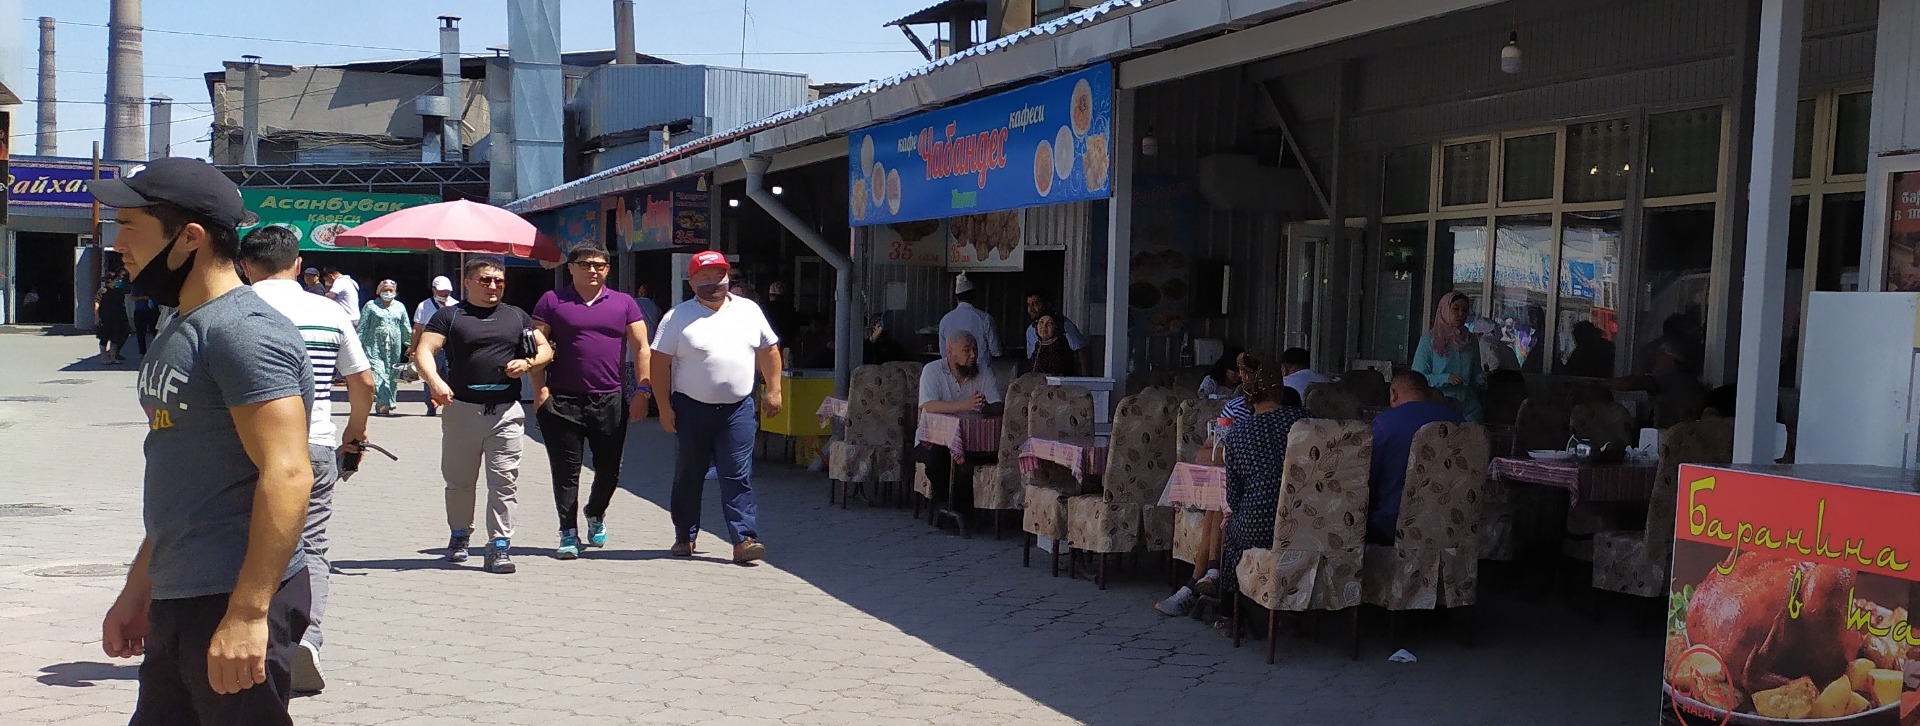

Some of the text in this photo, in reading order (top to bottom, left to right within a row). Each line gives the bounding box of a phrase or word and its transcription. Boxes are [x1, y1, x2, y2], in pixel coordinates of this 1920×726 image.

[897, 102, 1045, 190] кафе Чабандес кафеси
[307, 213, 361, 225] КАФЕСИ
[675, 229, 695, 244] 35
[889, 241, 914, 260] 35
[950, 244, 961, 263] 35
[1688, 476, 1909, 576] Баранина
[1788, 570, 1802, 619] в
[1683, 702, 1717, 721] HALAL
